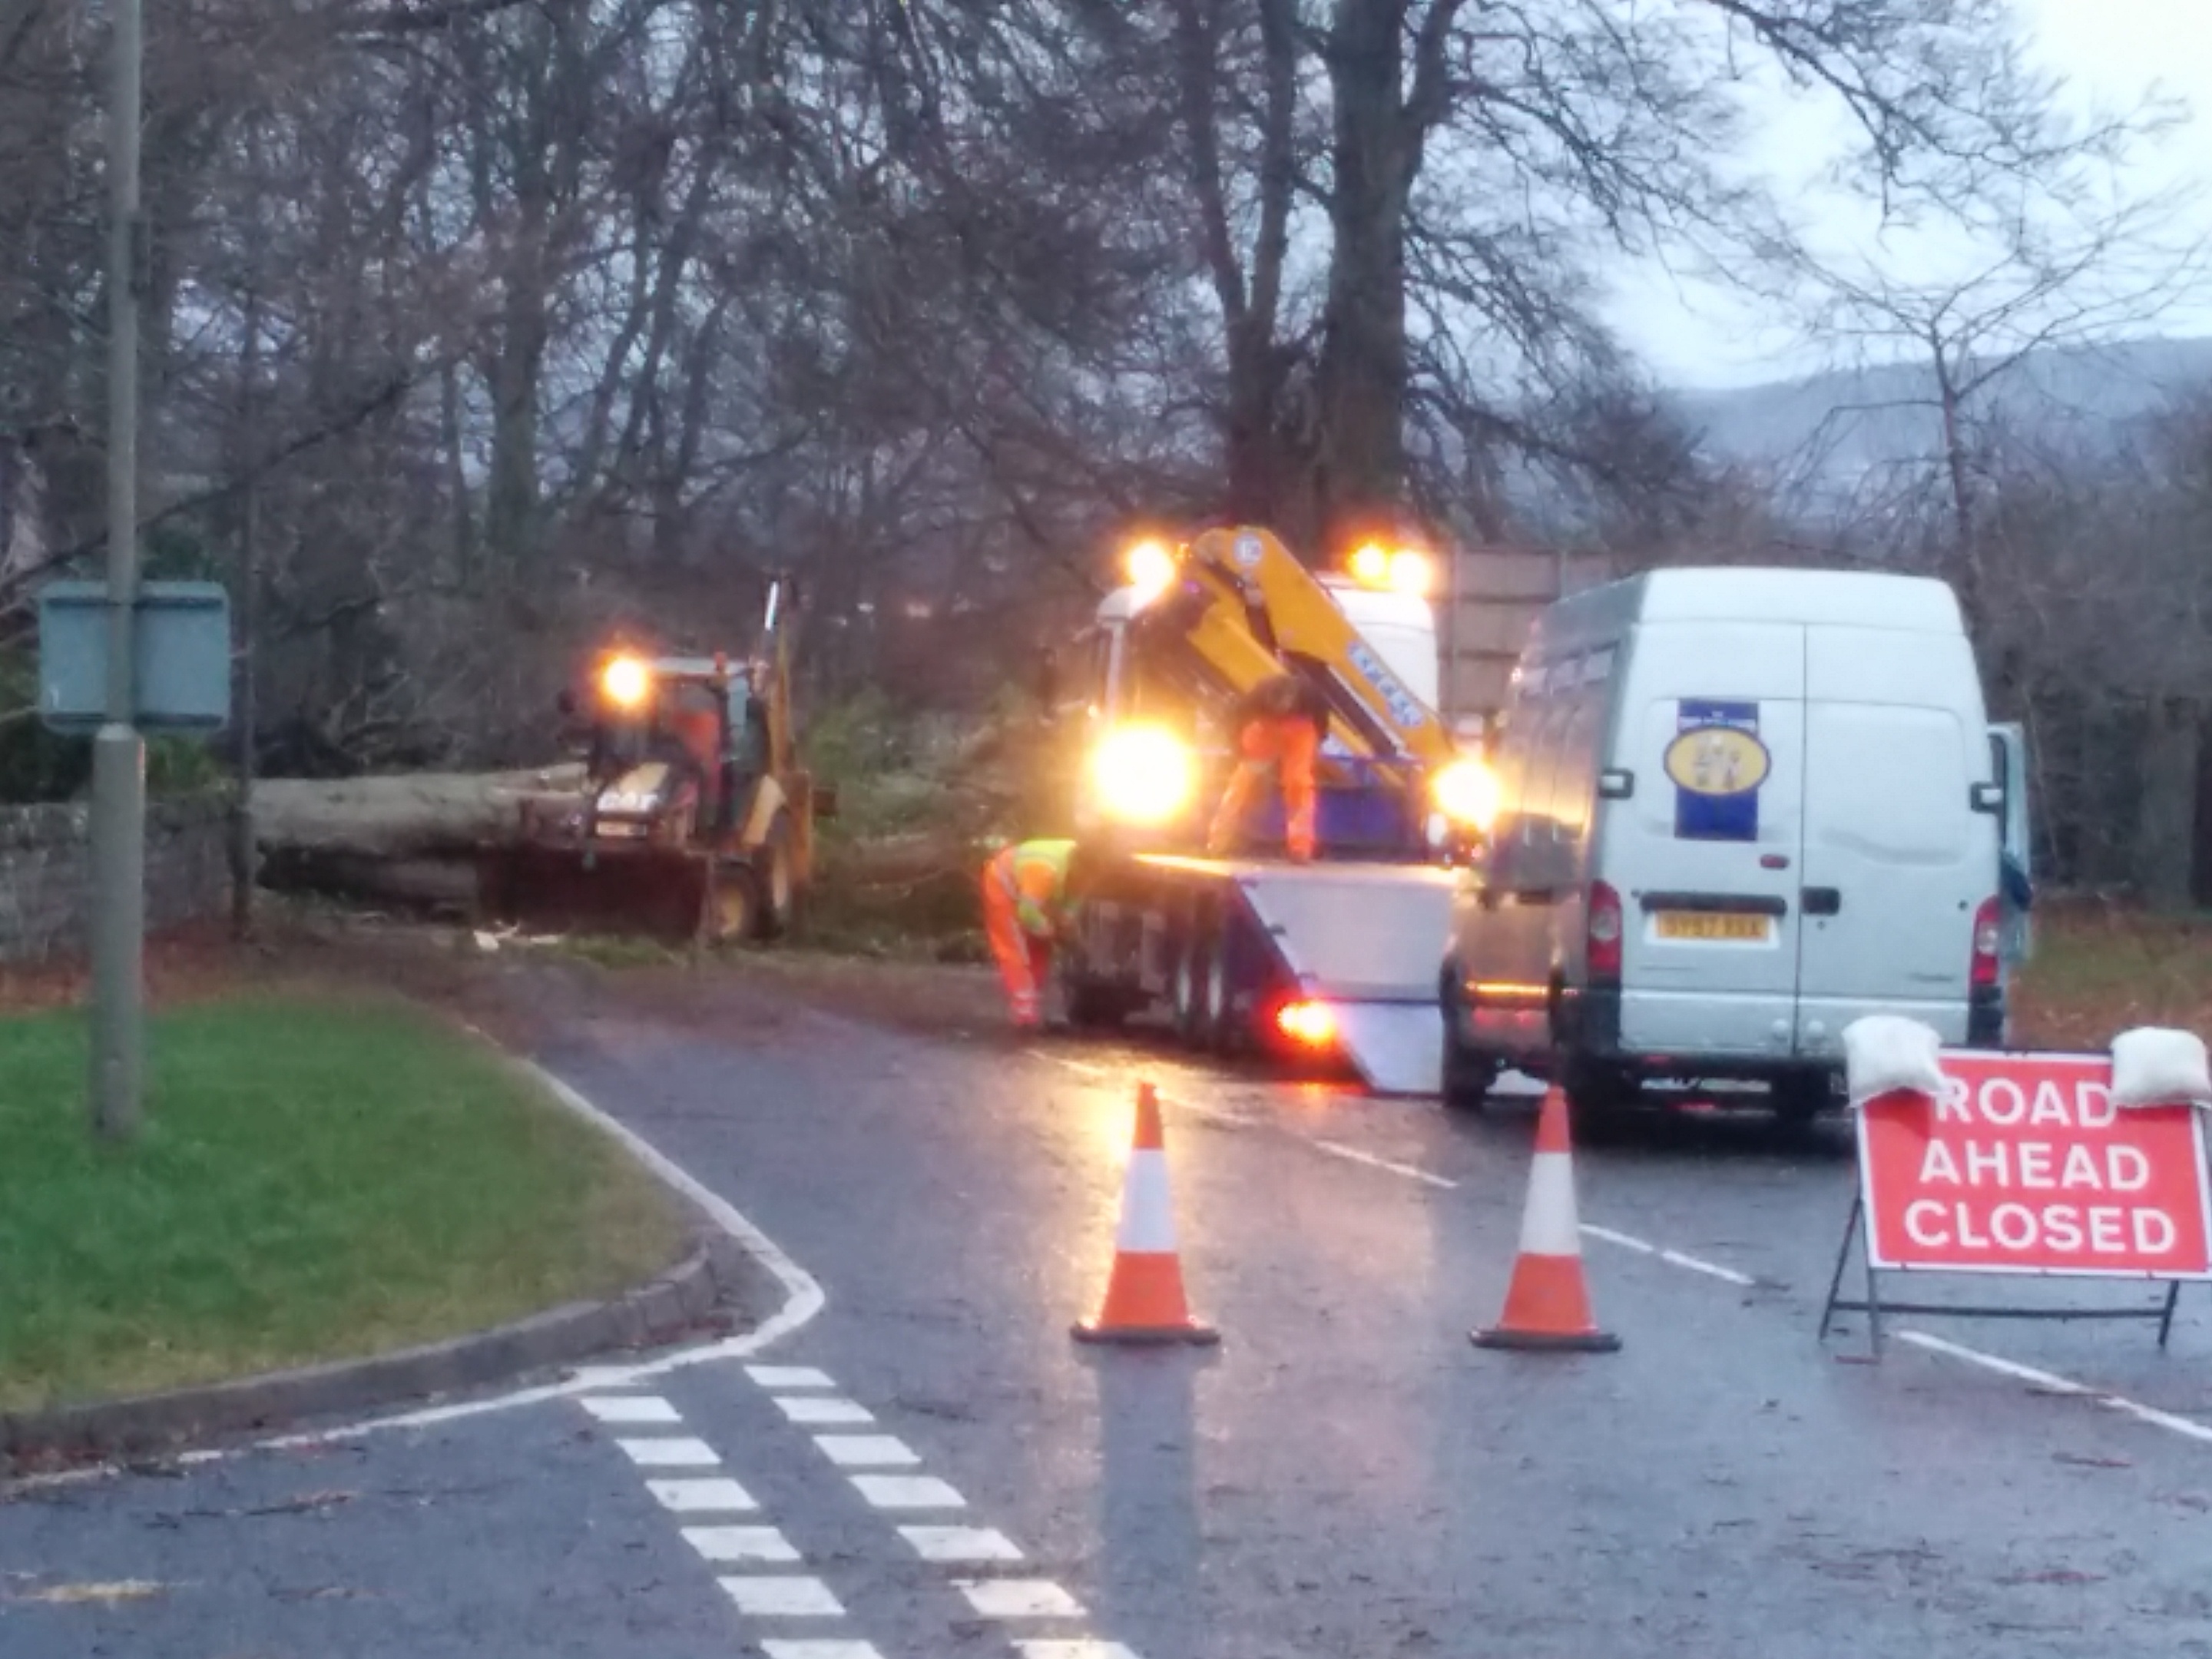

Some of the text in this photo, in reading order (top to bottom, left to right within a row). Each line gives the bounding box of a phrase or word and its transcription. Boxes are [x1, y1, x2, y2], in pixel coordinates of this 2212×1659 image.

[1935, 1078, 2117, 1128] ROAD
[1919, 1138, 2151, 1191] AHEAD
[1904, 1199, 2177, 1254] CLOSED
